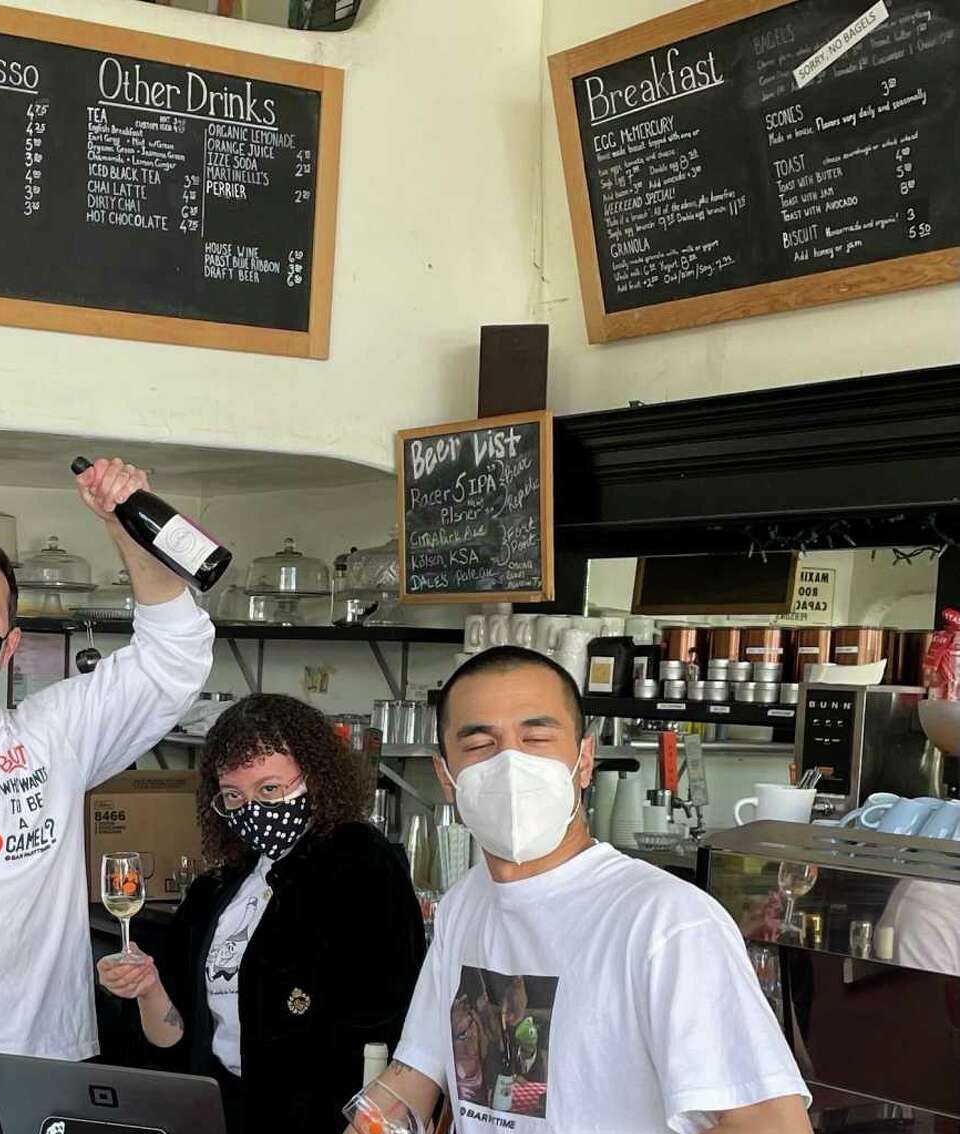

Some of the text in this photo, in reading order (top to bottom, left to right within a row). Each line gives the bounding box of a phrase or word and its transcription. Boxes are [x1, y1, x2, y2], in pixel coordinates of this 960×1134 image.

[828, 39, 843, 56] NO
[843, 11, 878, 44] BAGELS
[98, 56, 278, 125] Other Drinks
[585, 47, 724, 123] Breakfast
[87, 106, 108, 123] TEA
[765, 104, 804, 131] SCONES
[877, 101, 891, 113] and
[208, 123, 248, 142] ORGANIC
[251, 128, 296, 149] LEMONADE
[593, 131, 617, 152] EGG
[207, 138, 275, 159] ORANGE JUICE
[207, 152, 258, 171] IZZE SODA
[772, 153, 806, 178] TOAST
[89, 163, 161, 185] ICED BLACK TEA
[777, 167, 843, 193] TOAST WITH BUTTER
[88, 180, 147, 200] CHAI LATTE
[206, 180, 247, 199] PERRIER
[778, 187, 835, 208] TOAST WITH JAM
[87, 194, 141, 212] DIRTY CHAI
[780, 196, 858, 222] TOAST WITH AVOCADO
[86, 209, 107, 223] HOT
[108, 212, 168, 231] CHOCOLATE
[782, 224, 818, 249] BISCUIT
[205, 243, 259, 259] HOUSE WINE
[610, 237, 651, 259] GRANOLA
[794, 250, 809, 262] Add
[846, 240, 863, 254] jam
[204, 255, 230, 268] PABST
[250, 259, 281, 274] RIBBON
[204, 265, 260, 284] DRAFT BEER
[411, 426, 522, 481] Beer List
[411, 486, 452, 510] Racer
[468, 473, 497, 496] IPA
[449, 547, 480, 566] KSA
[808, 700, 853, 710] BUNN
[27, 791, 44, 813] BE
[19, 816, 28, 830] A
[94, 811, 126, 821] 8466
[5, 818, 56, 853] CAMEL?
